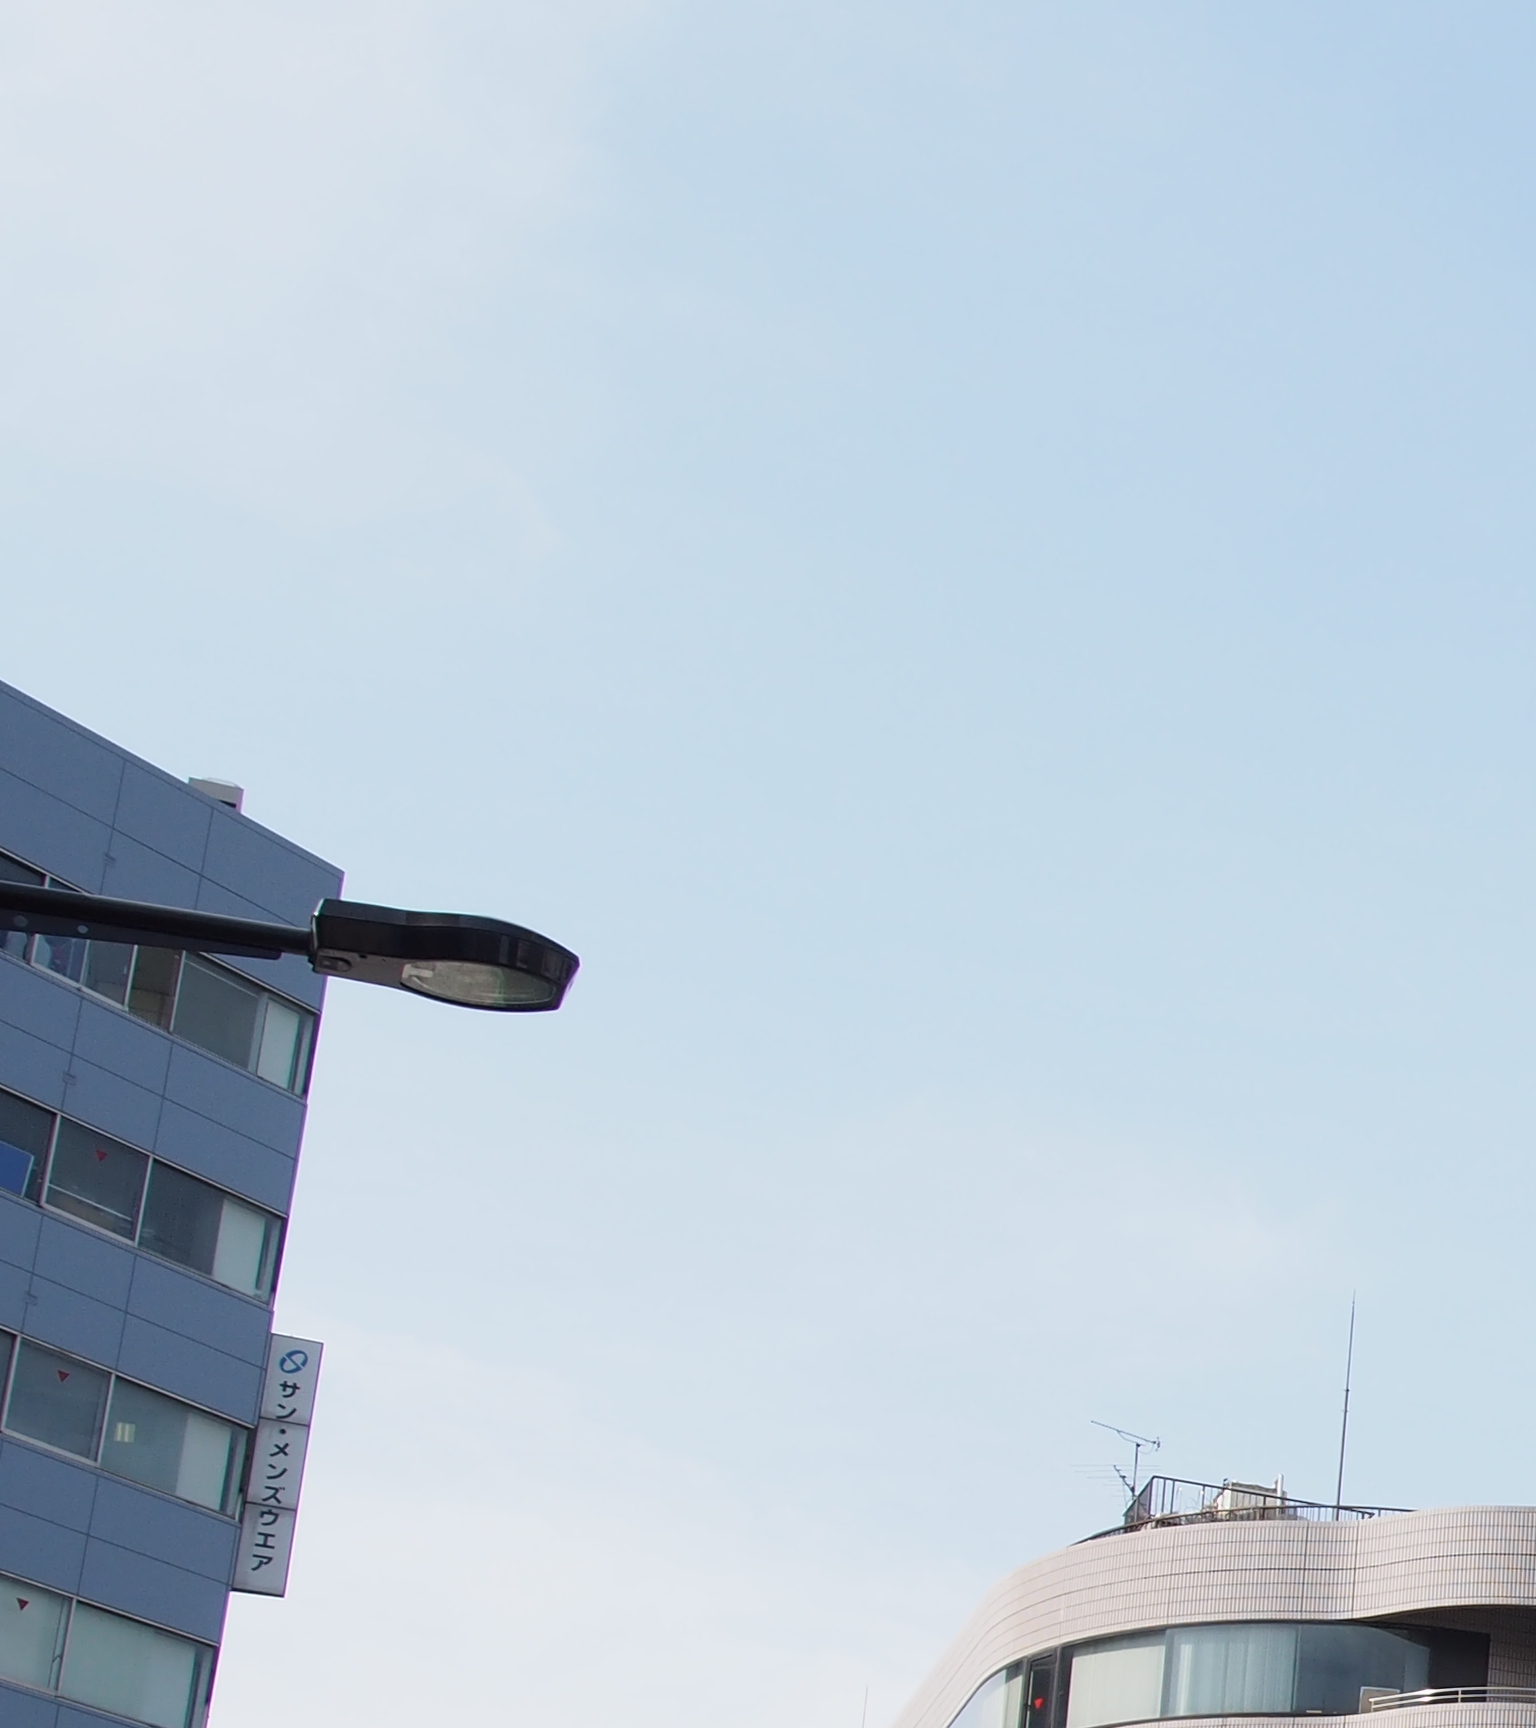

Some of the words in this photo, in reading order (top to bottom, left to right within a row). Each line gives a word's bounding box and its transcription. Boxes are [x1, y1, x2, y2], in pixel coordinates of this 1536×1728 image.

[250, 1379, 301, 1572] サン・メンズウエア
